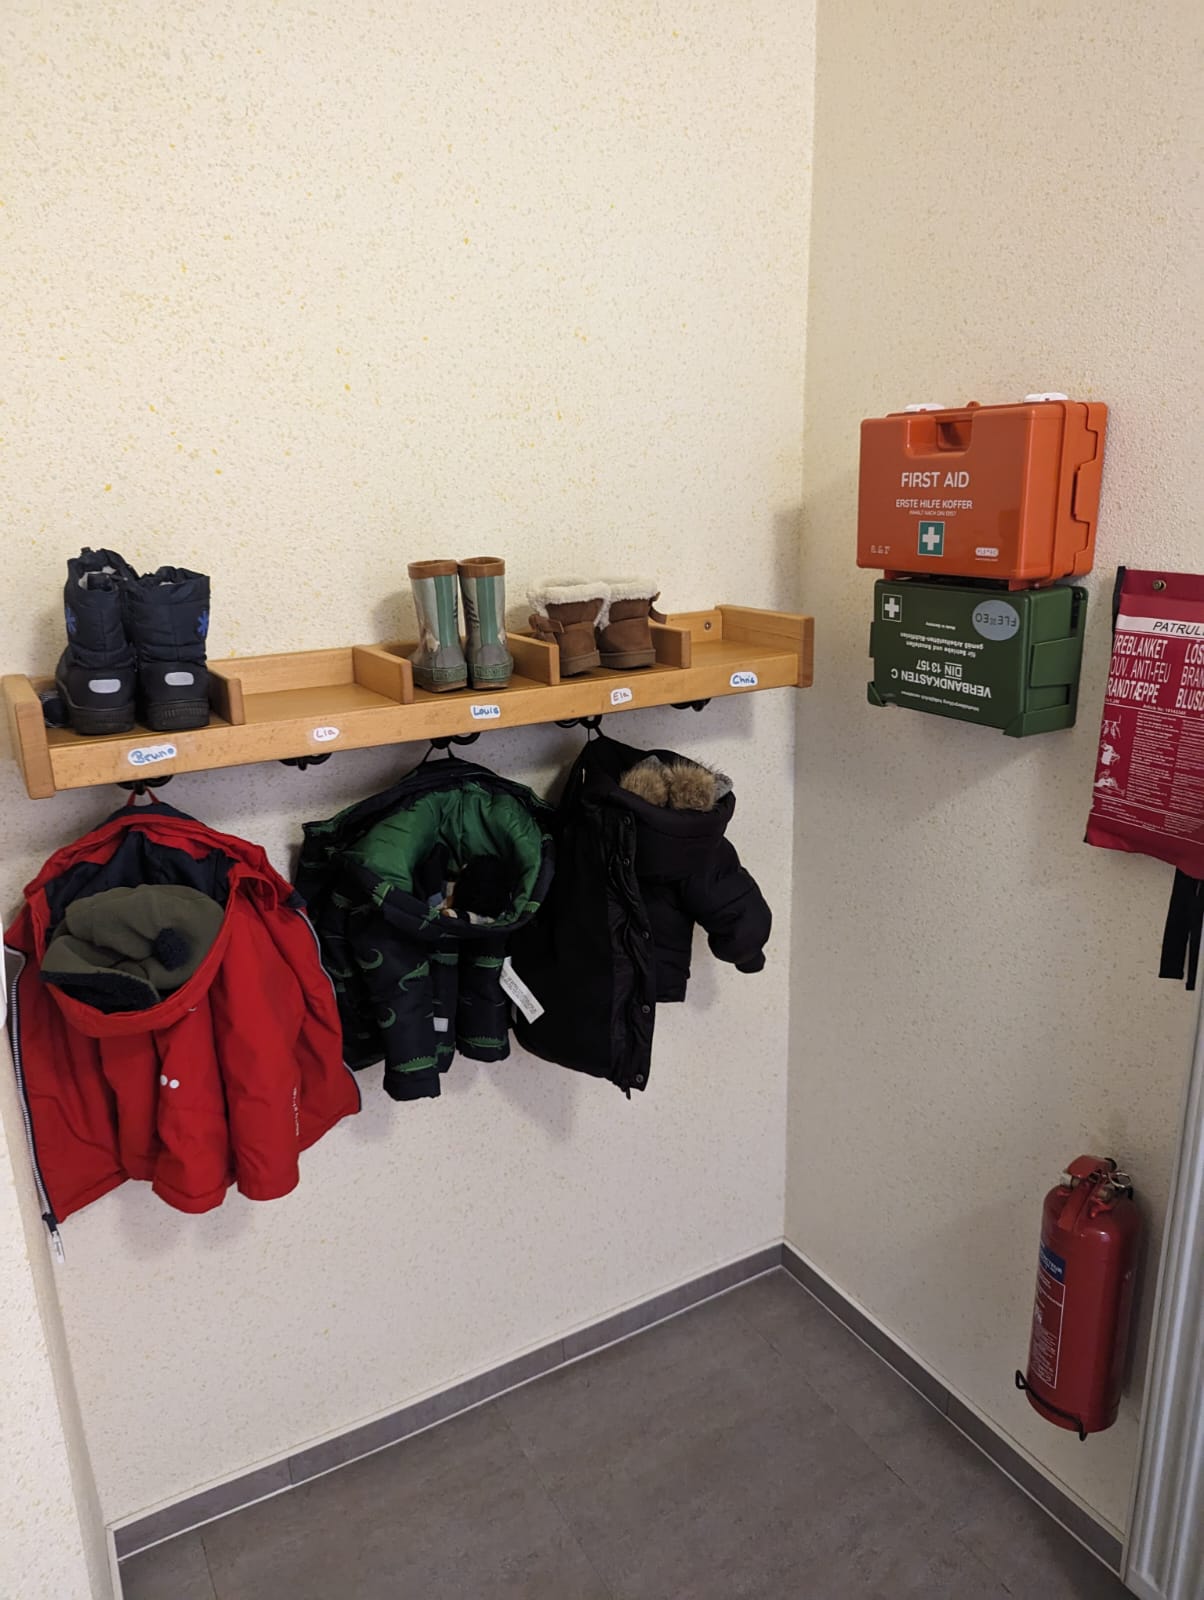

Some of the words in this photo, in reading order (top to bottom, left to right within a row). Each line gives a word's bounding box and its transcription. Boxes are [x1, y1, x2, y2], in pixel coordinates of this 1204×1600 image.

[901, 471, 940, 488] FIRST
[944, 471, 970, 488] AID
[896, 499, 918, 508] ERSTE
[920, 499, 941, 509] HILFE
[942, 500, 973, 510] KOFFER
[1152, 621, 1204, 636] PATRUL
[891, 668, 899, 679] C
[944, 664, 962, 678] DIN
[1130, 659, 1171, 683] ANTI-FEU
[901, 670, 992, 699] VERBANDKASTEN
